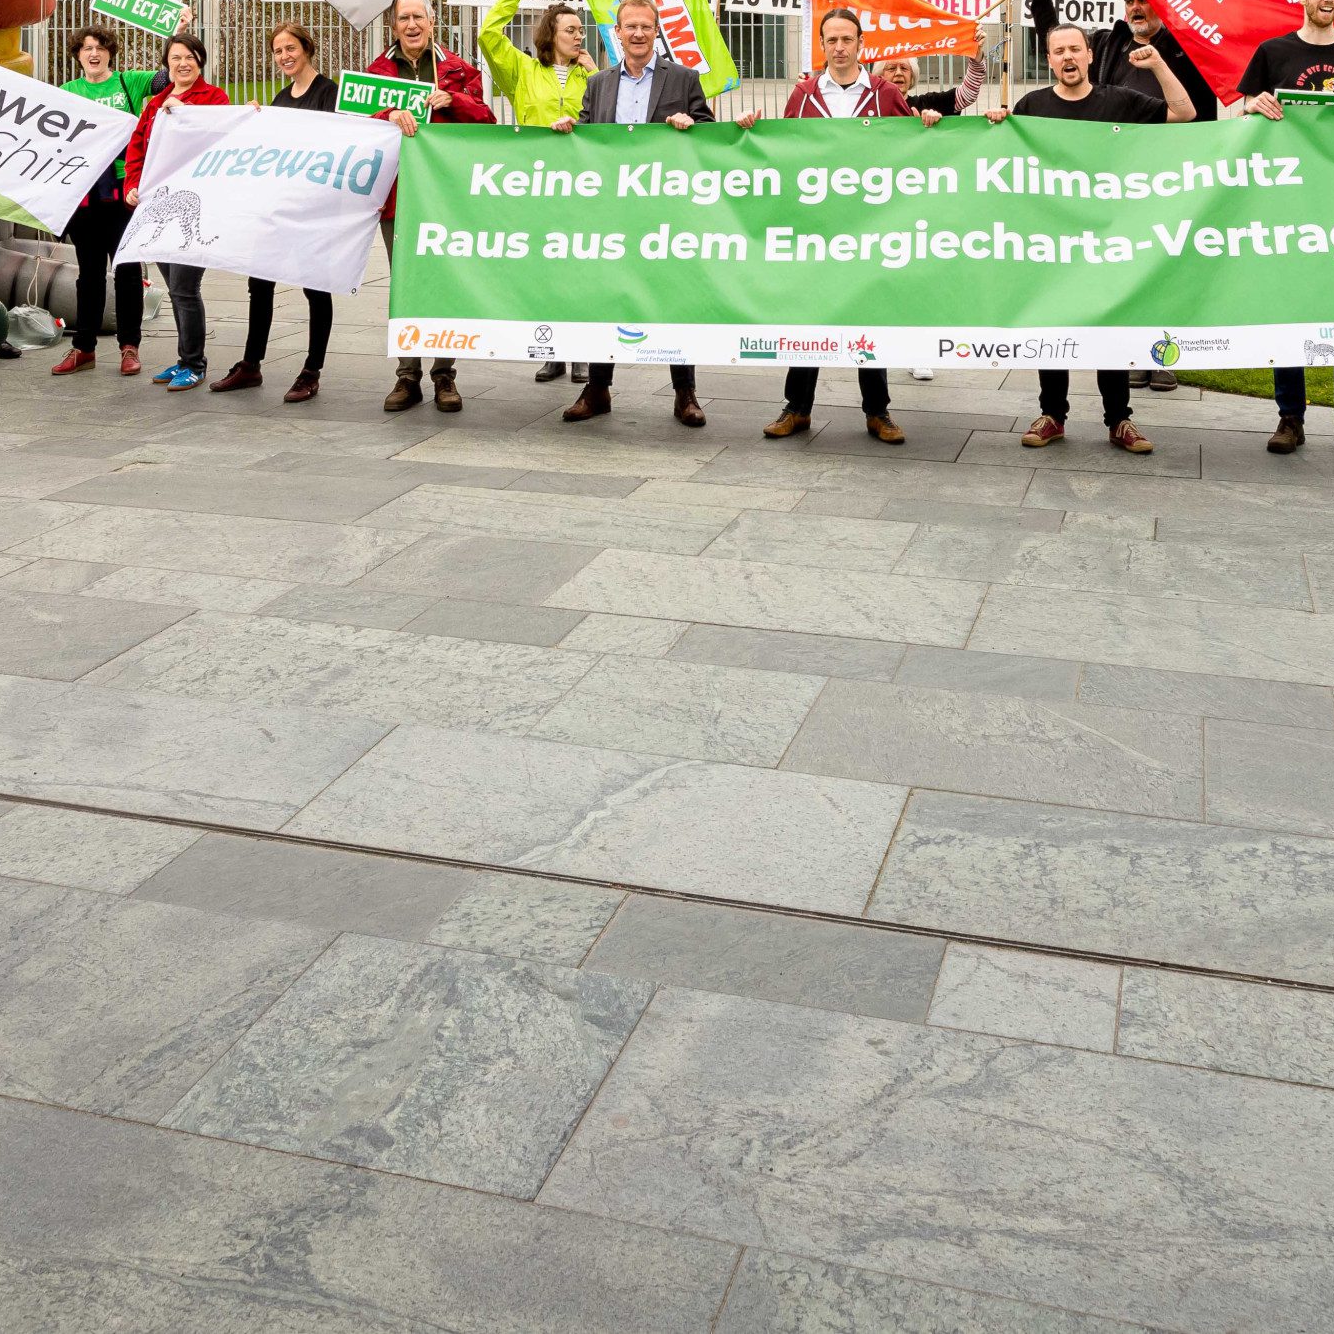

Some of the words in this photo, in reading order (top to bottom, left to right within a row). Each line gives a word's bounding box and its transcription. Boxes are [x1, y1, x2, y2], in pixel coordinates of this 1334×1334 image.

[343, 82, 376, 104] EXIT
[378, 87, 406, 109] ECT
[192, 144, 384, 196] urgewald
[470, 160, 602, 197] Keine
[617, 162, 781, 205] Klagen
[796, 166, 958, 205] gegen
[975, 152, 1303, 199] Klimaschutz
[416, 222, 529, 259] Raus
[543, 229, 626, 259] aus
[639, 223, 747, 261] dem
[424, 330, 480, 350] attac
[740, 337, 838, 352] NaturFreunde
